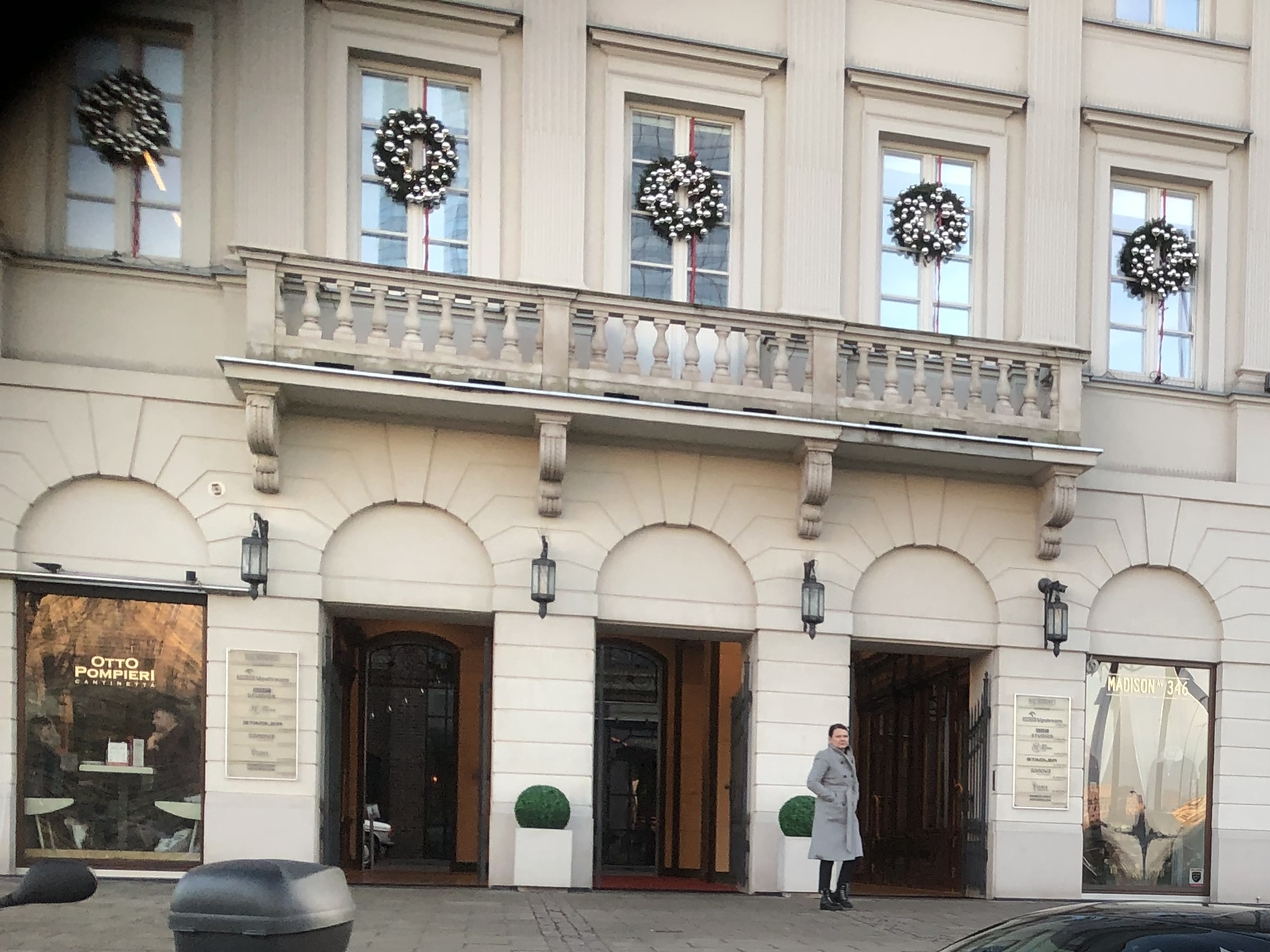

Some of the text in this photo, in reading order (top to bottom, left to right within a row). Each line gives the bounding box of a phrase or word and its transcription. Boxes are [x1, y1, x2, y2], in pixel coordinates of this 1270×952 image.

[75, 666, 155, 681] POMPIERI
[75, 679, 155, 688] CANTINETTA
[1107, 676, 1155, 694] MADISON
[1167, 680, 1189, 696] 346
